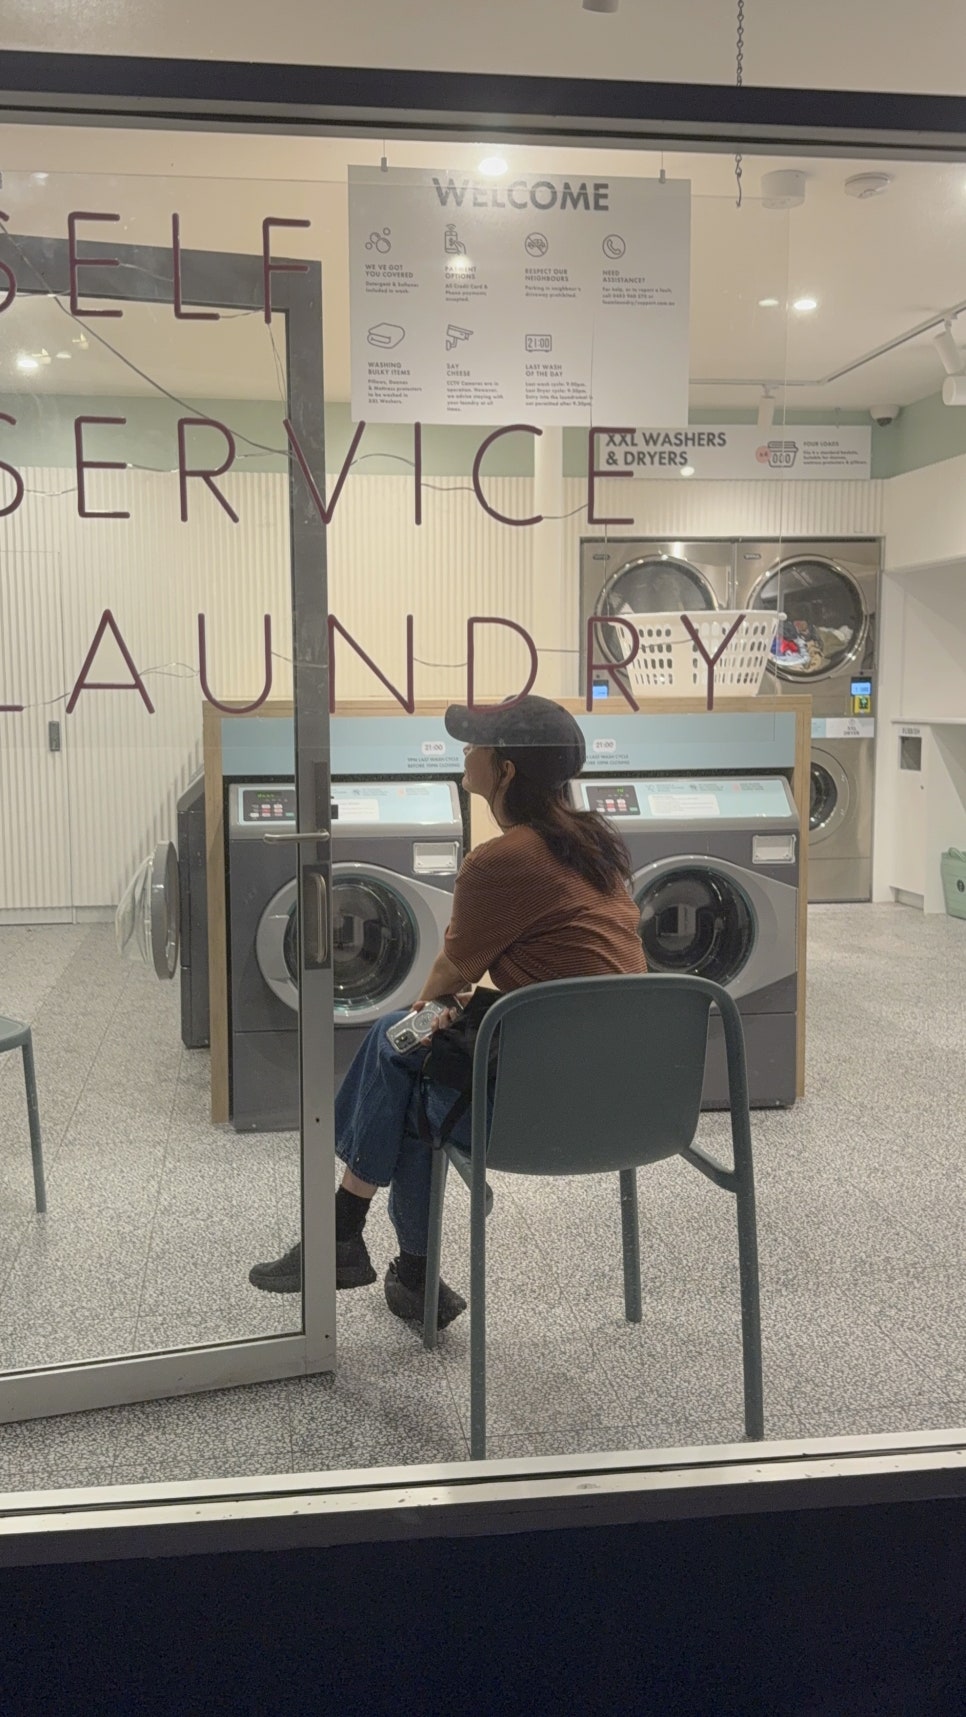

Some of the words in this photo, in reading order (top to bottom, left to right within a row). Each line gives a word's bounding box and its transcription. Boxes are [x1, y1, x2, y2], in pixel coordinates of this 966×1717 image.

[432, 178, 609, 210] WELCOME
[528, 338, 549, 348] 21:00
[606, 433, 638, 447] XXL
[642, 432, 727, 447] WASHERS
[606, 451, 618, 466] &
[624, 451, 688, 466] DRYERS
